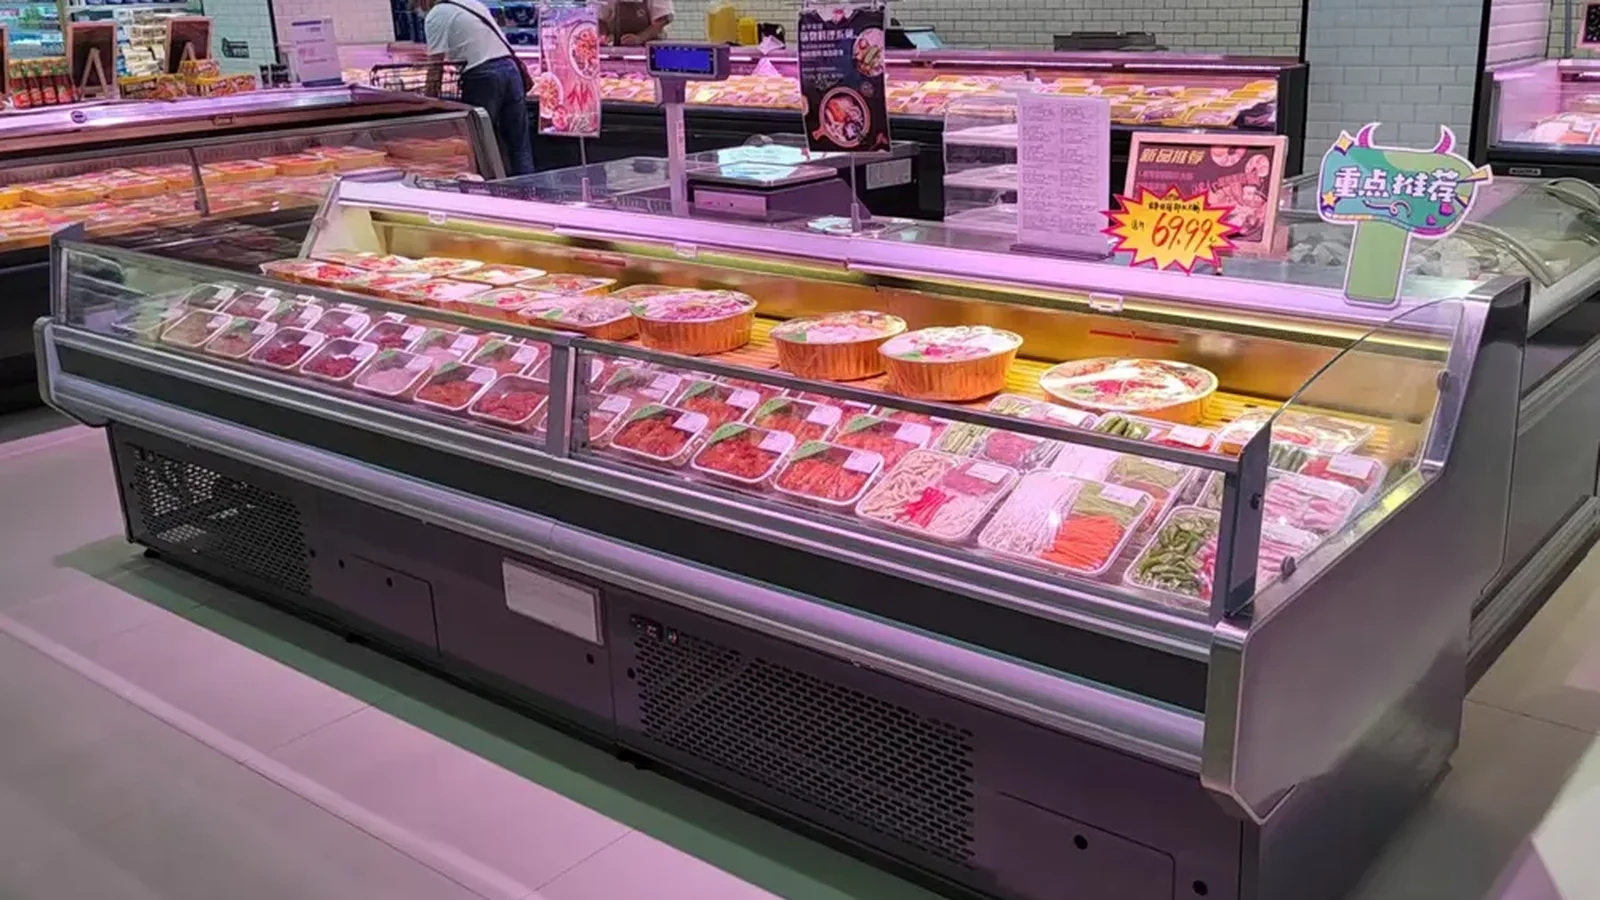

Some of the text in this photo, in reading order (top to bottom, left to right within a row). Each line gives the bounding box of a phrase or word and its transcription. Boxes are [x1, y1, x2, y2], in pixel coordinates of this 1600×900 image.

[1139, 147, 1206, 165] 新品推荐
[1333, 166, 1460, 202] 重点推荐
[1151, 212, 1214, 253] 69.99
